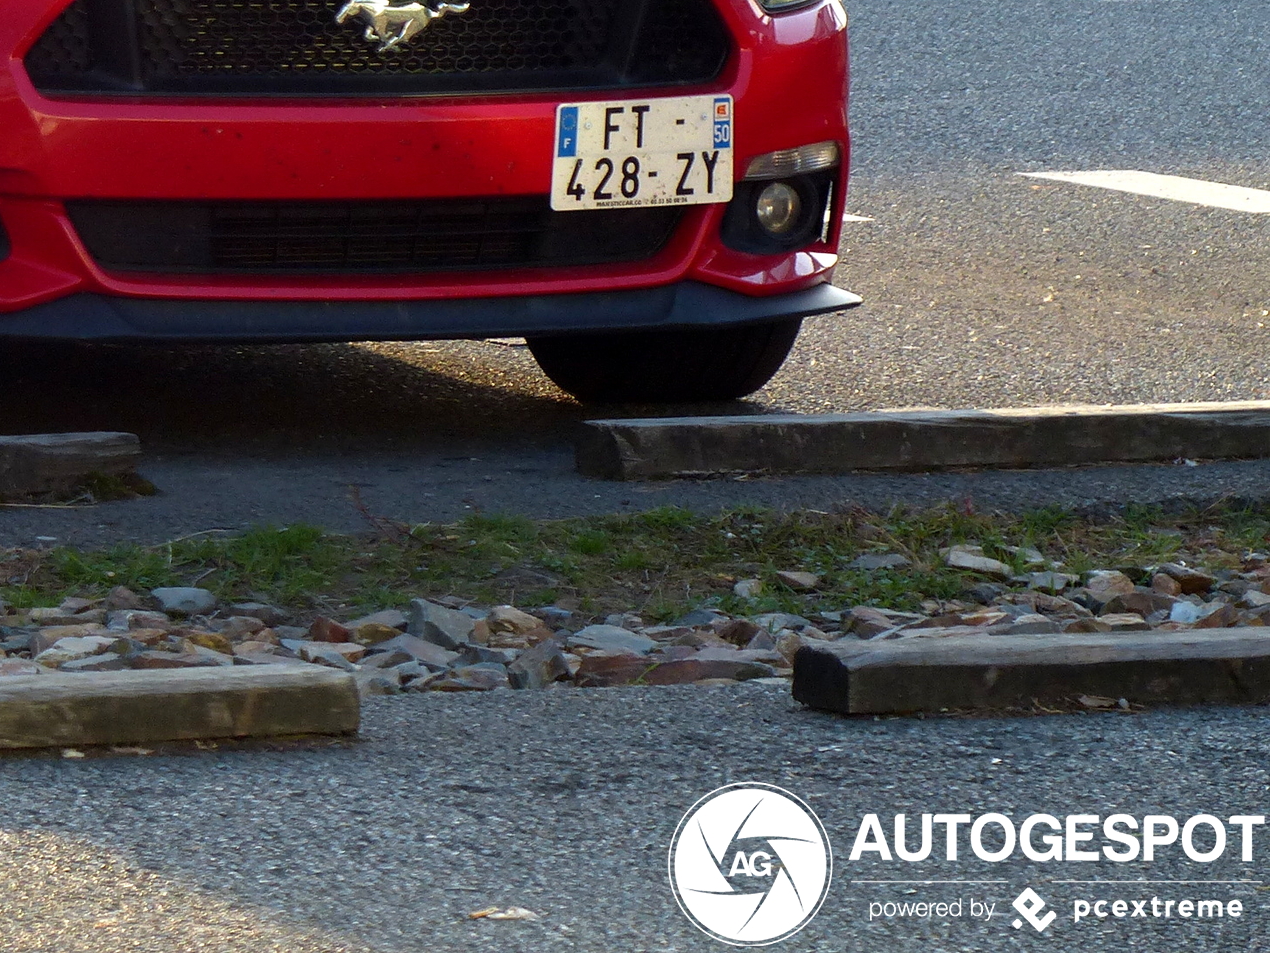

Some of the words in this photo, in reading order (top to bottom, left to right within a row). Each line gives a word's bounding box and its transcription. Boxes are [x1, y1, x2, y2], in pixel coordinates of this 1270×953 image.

[603, 105, 650, 150] FT
[714, 124, 730, 143] 50
[563, 137, 572, 149] F
